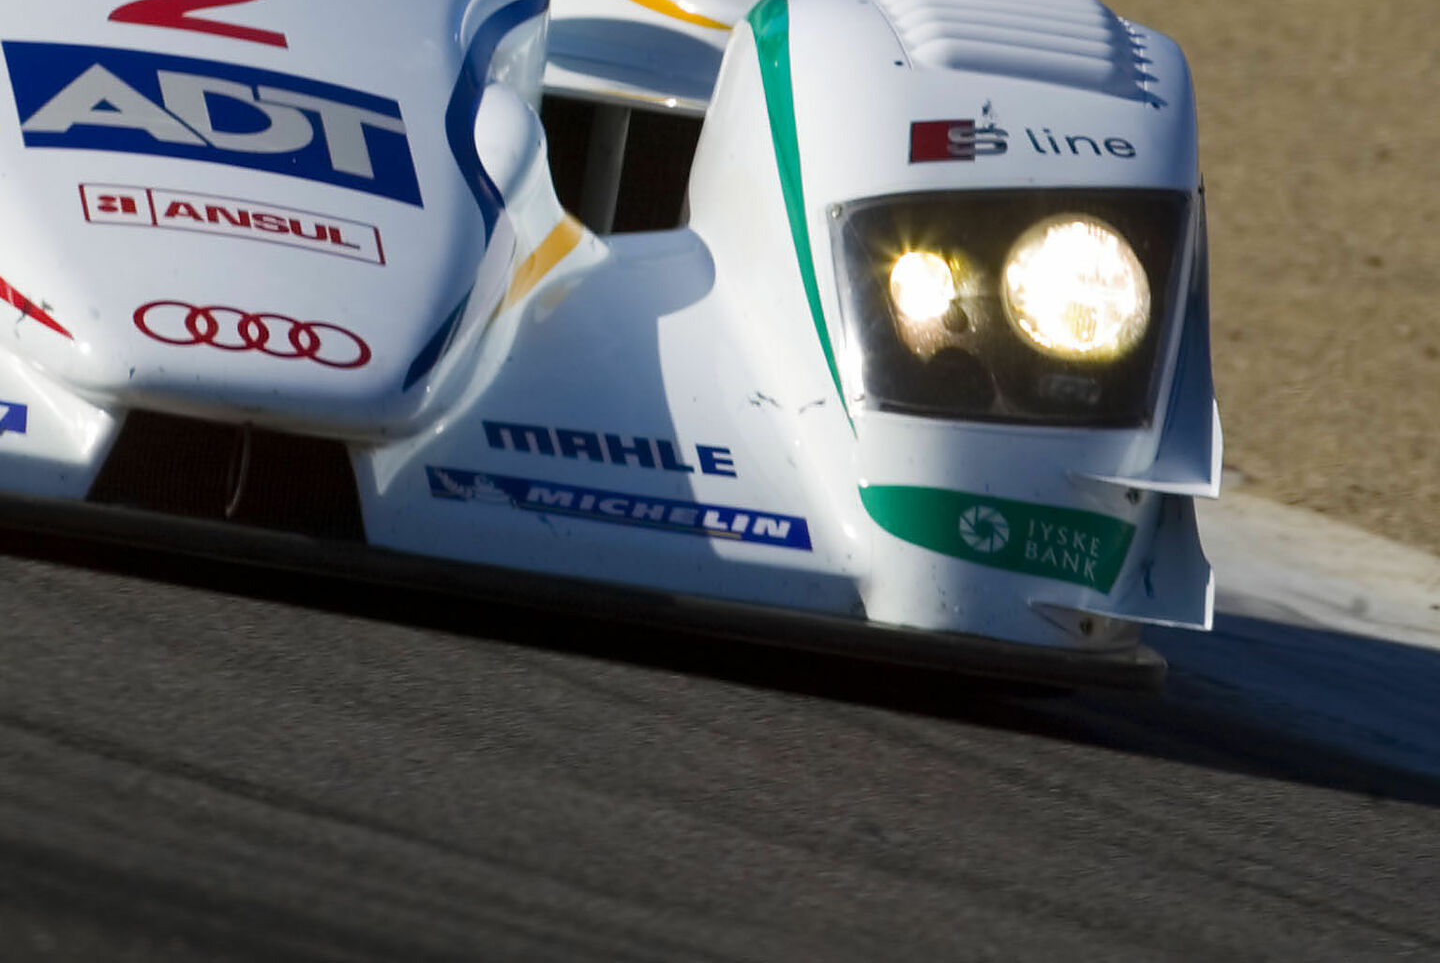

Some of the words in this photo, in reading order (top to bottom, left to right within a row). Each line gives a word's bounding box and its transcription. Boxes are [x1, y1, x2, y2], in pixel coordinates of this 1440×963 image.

[20, 62, 407, 180] ADT
[1024, 127, 1137, 159] line
[163, 201, 361, 250] ANSUL
[481, 420, 738, 477] MAHLE
[526, 486, 792, 540] MICHELIN
[1024, 540, 1097, 583] BANK
[1027, 518, 1102, 558] JYSKE
